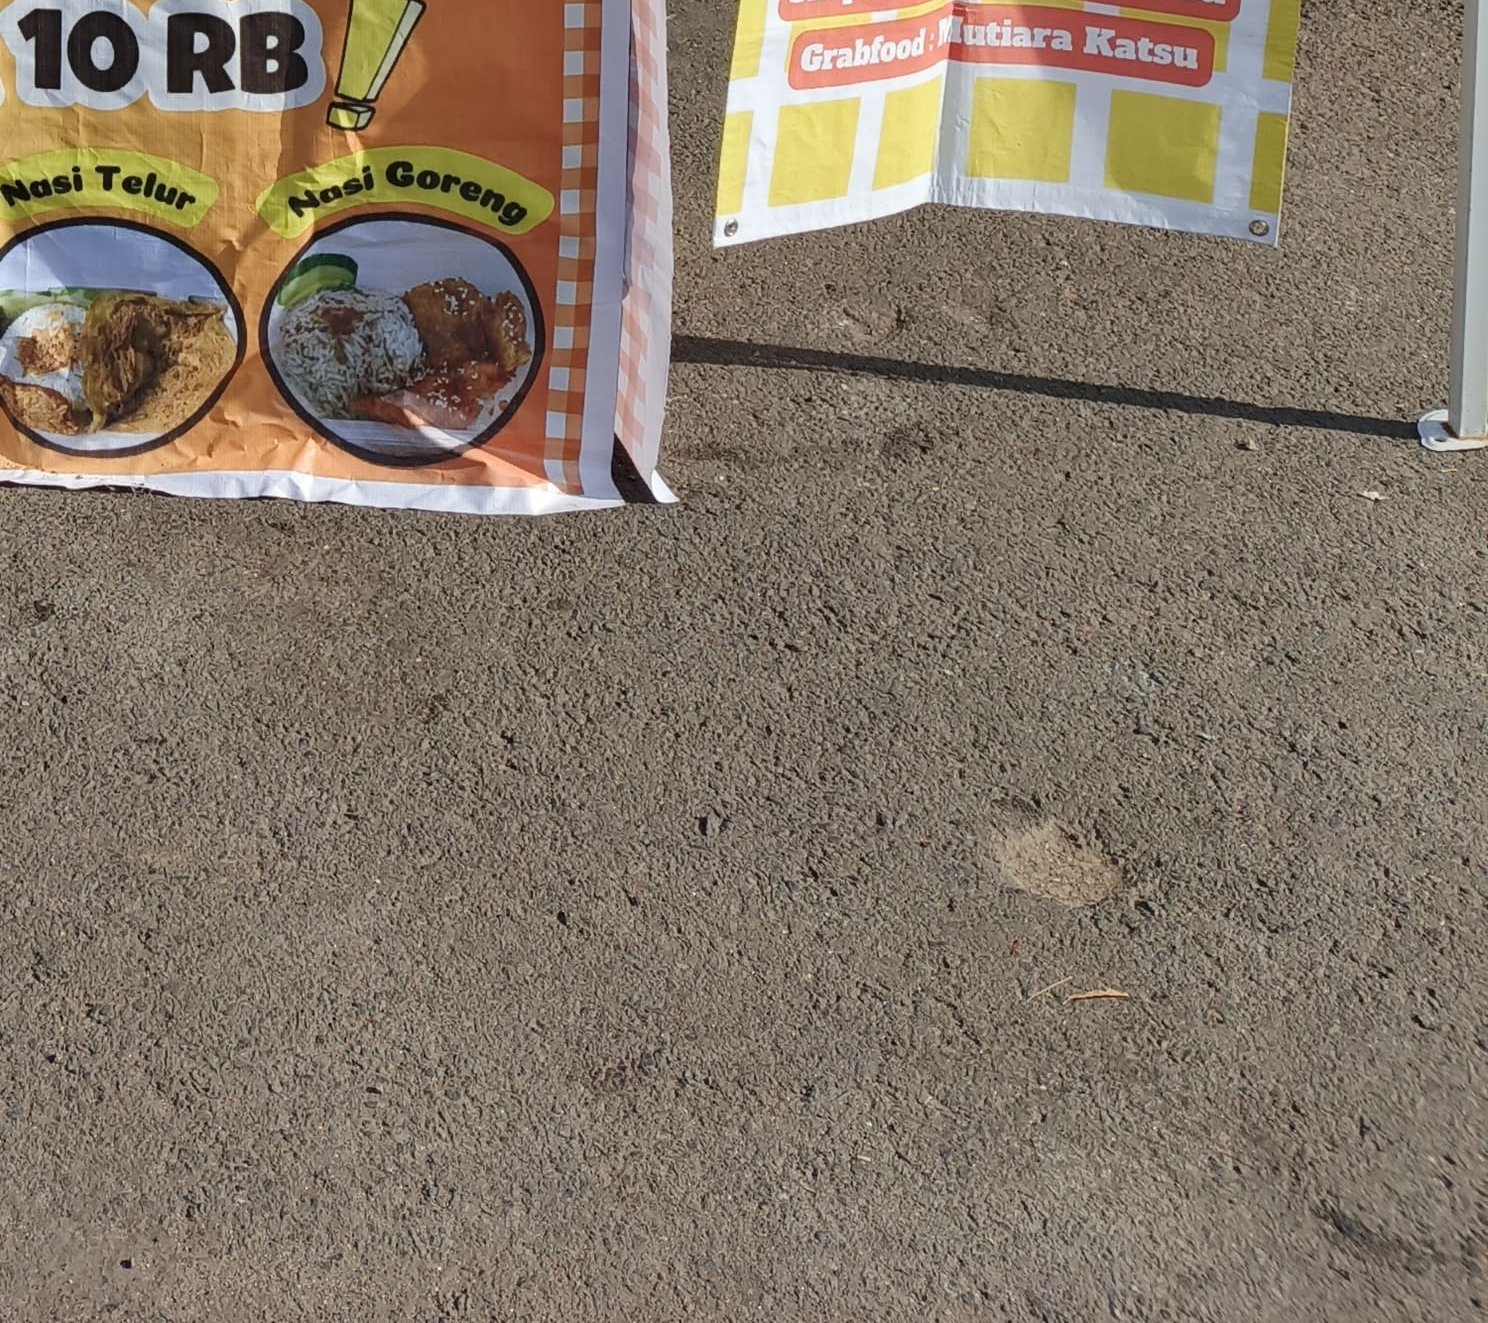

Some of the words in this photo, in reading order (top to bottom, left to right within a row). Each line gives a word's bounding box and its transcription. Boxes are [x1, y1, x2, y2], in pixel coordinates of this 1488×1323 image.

[17, 3, 140, 93] 10
[800, 28, 924, 72] Grabfood
[937, 15, 1072, 52] Mutiara
[1083, 26, 1199, 70] Katsu
[0, 166, 83, 207] Nasi
[95, 166, 198, 212] Telur
[287, 166, 374, 218] Nasi
[386, 161, 528, 227] Goreng
